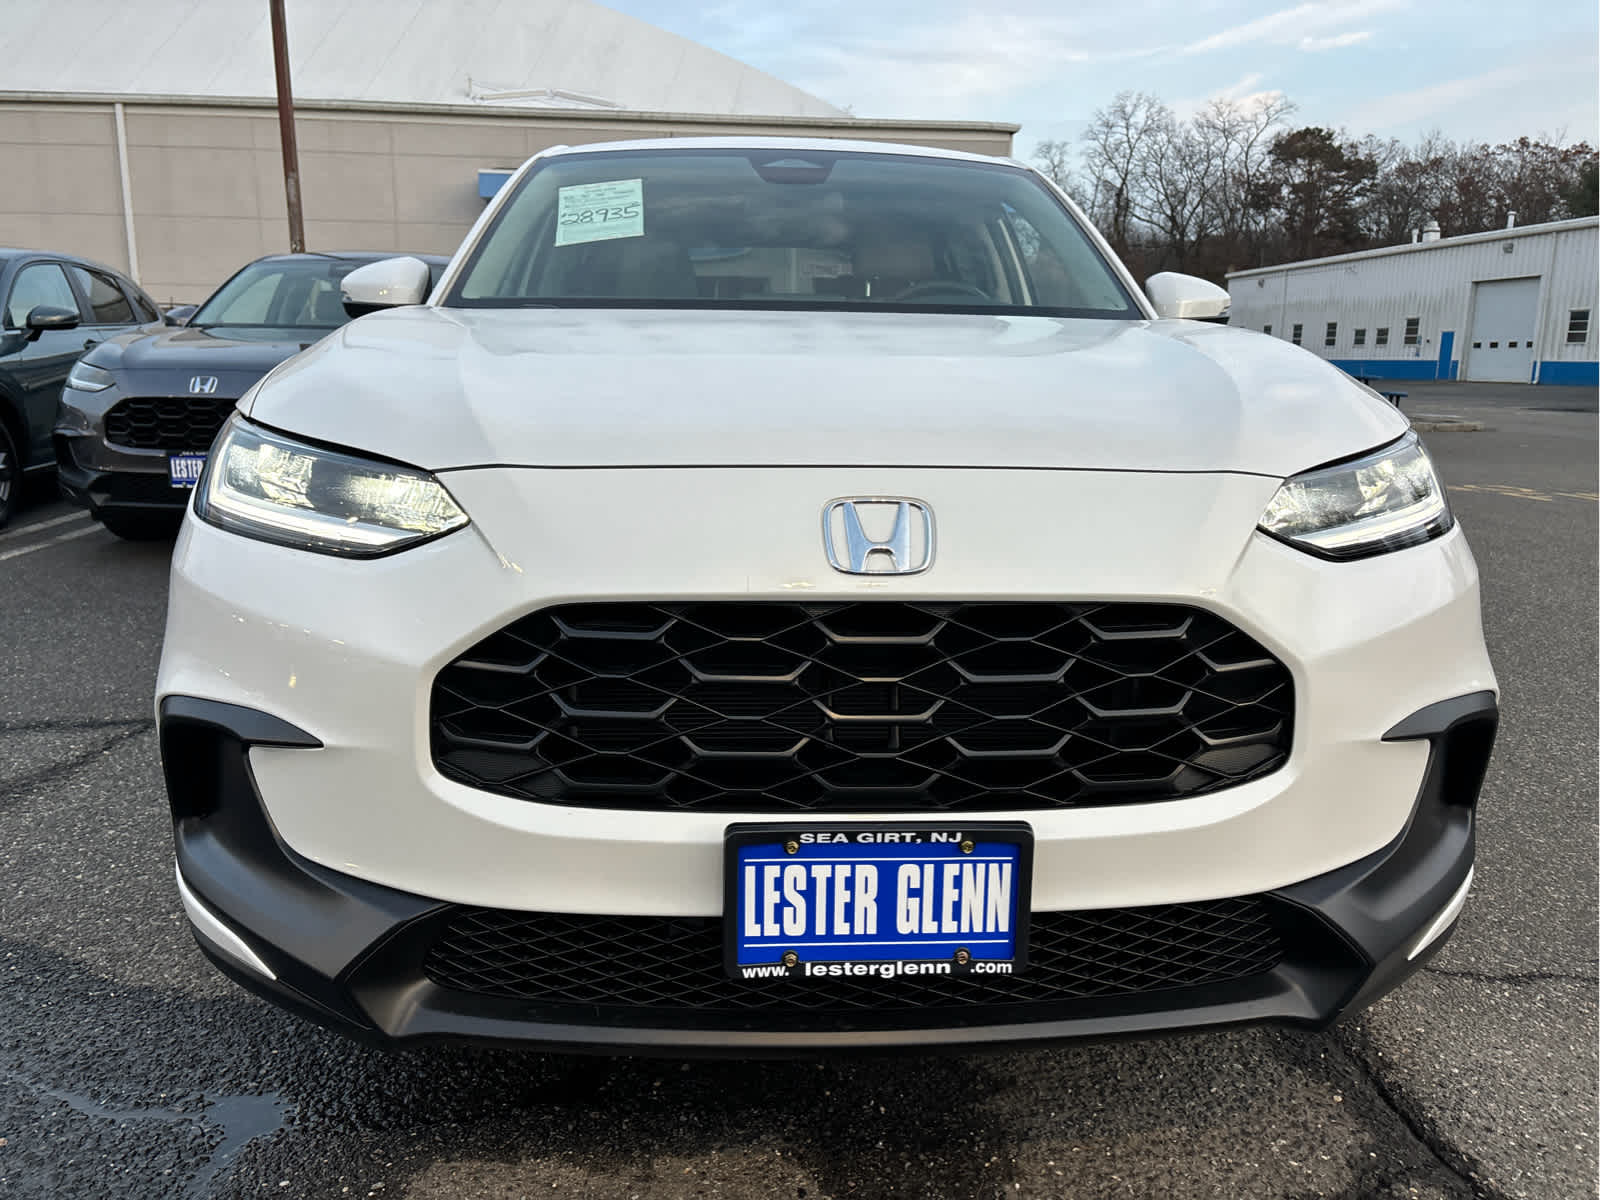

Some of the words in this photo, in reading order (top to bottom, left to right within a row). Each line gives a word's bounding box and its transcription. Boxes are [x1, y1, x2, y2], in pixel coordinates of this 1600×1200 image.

[799, 833, 848, 843] SEA
[856, 832, 922, 844] GIRT,
[930, 832, 962, 843] NJ
[744, 864, 879, 937] LESTER
[896, 863, 1012, 935] GLENN
[742, 966, 790, 979] www.
[805, 961, 951, 979] lesterglenn
[970, 962, 1013, 974] .com
